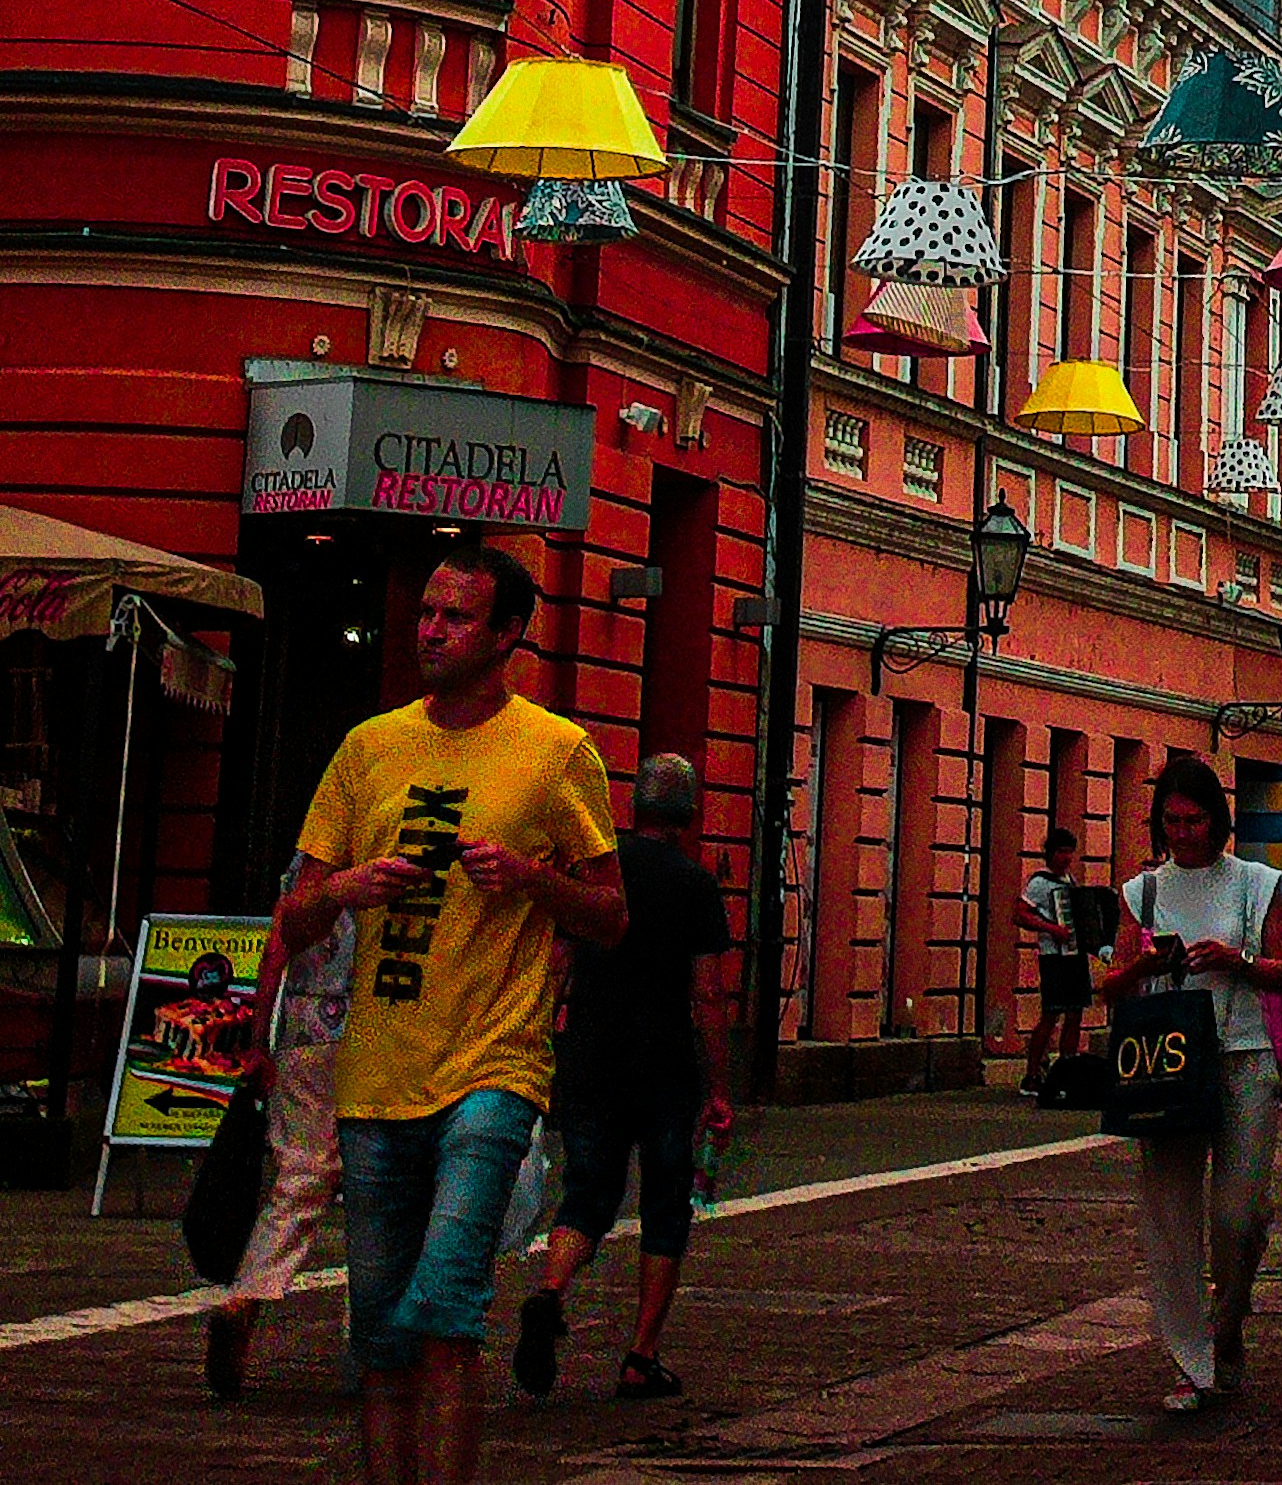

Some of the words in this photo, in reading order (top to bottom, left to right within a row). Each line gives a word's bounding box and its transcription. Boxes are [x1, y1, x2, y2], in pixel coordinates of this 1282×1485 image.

[373, 432, 568, 491] CITADELA
[251, 468, 337, 495] CITADELA
[371, 470, 567, 525] RESTORAN
[252, 489, 334, 513] RESTORAN
[153, 929, 266, 956] Benvenut
[1118, 1032, 1187, 1078] OVS
